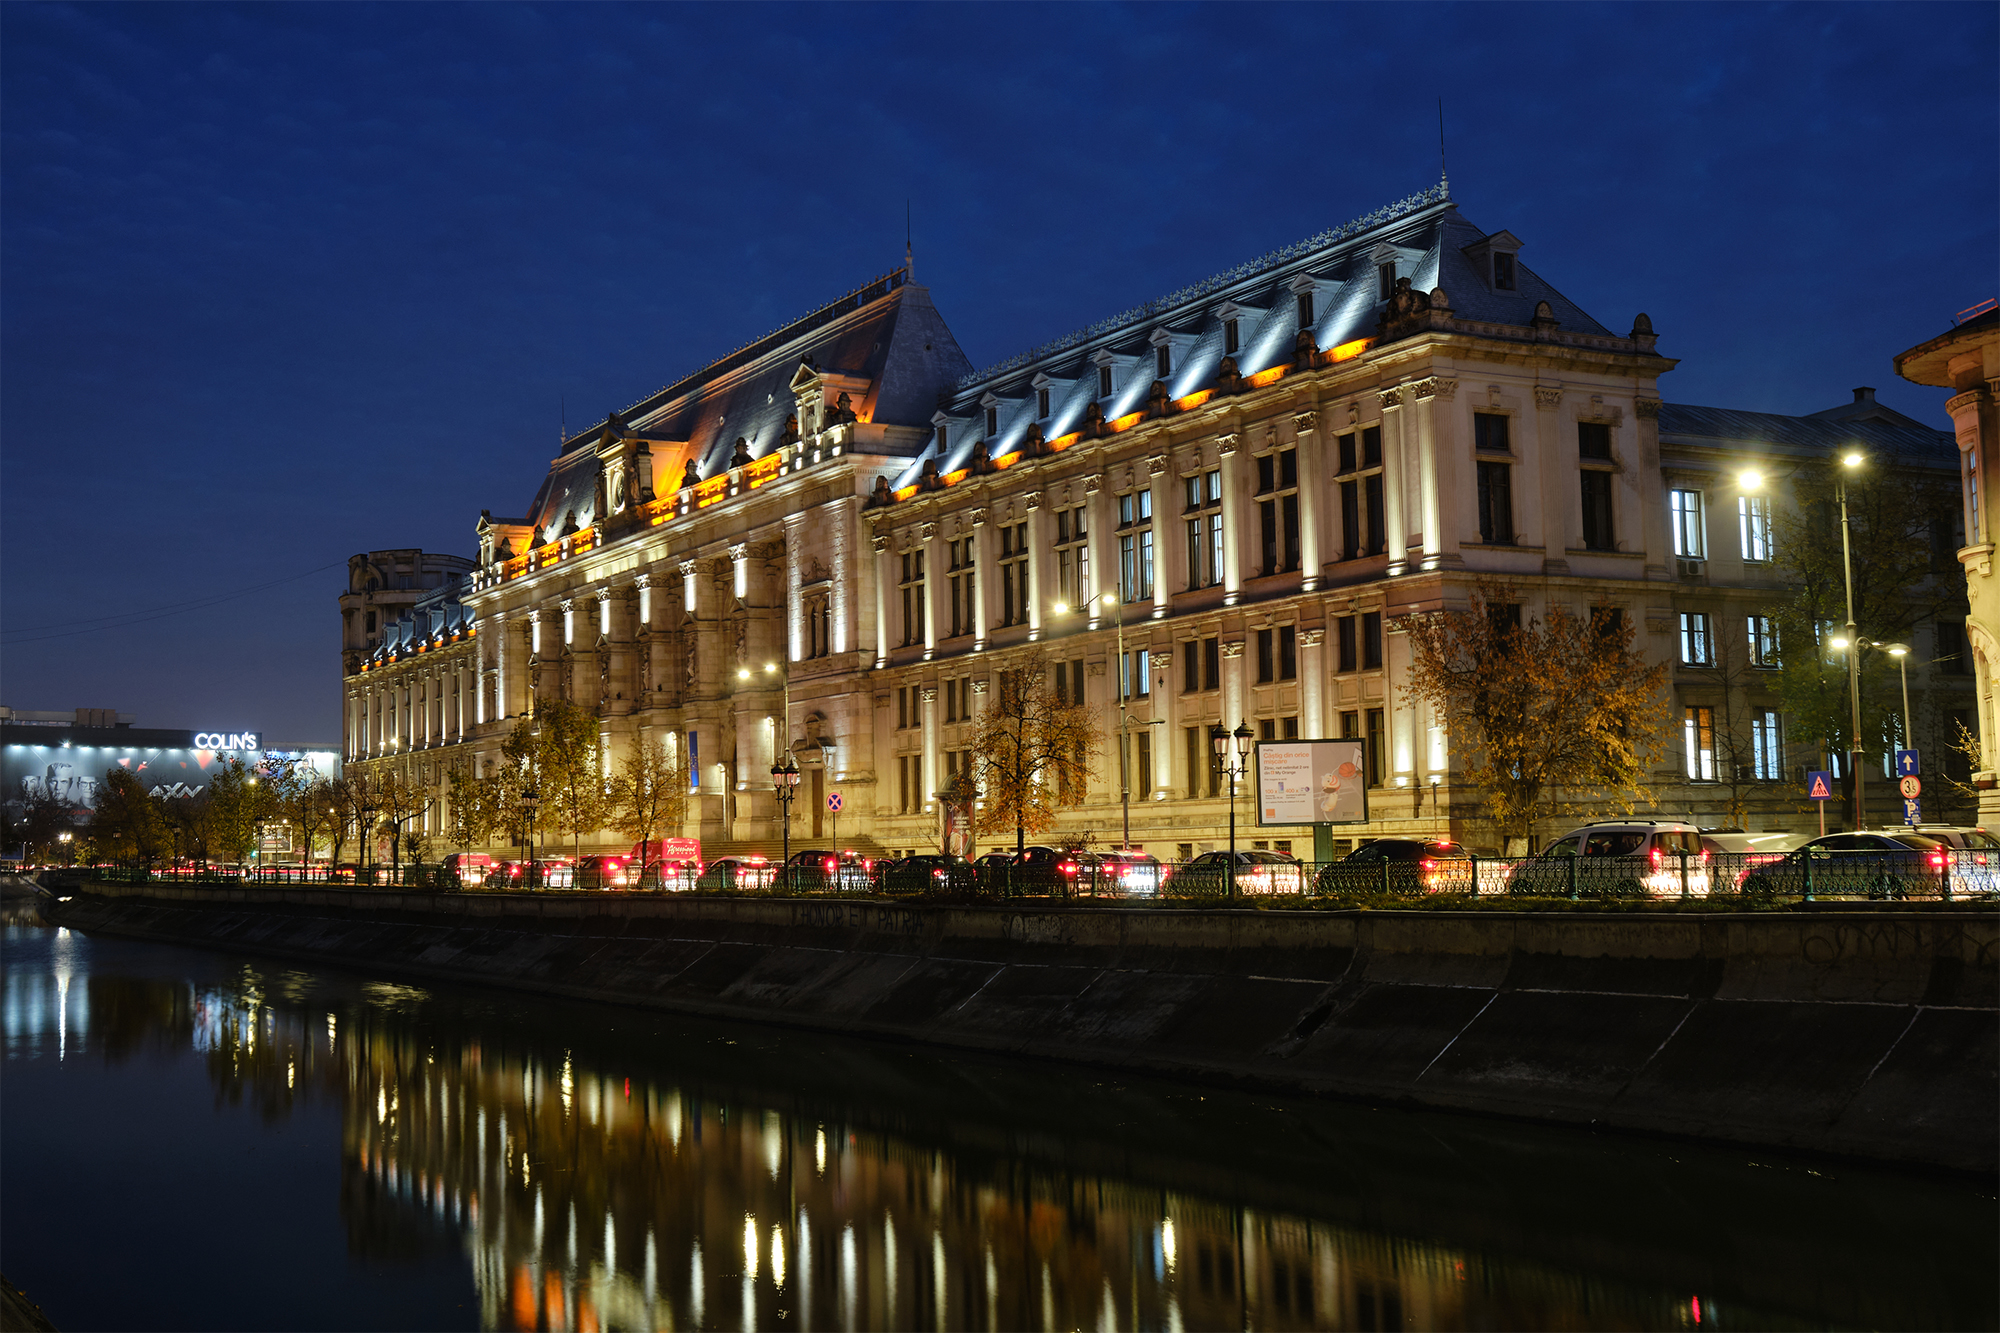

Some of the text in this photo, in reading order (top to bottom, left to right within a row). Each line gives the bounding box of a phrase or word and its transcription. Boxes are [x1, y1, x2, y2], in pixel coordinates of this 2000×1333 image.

[194, 731, 257, 751] COLIN'S
[147, 782, 205, 803] AXN
[801, 903, 844, 927] HONOR
[878, 907, 924, 934] PATRIA
